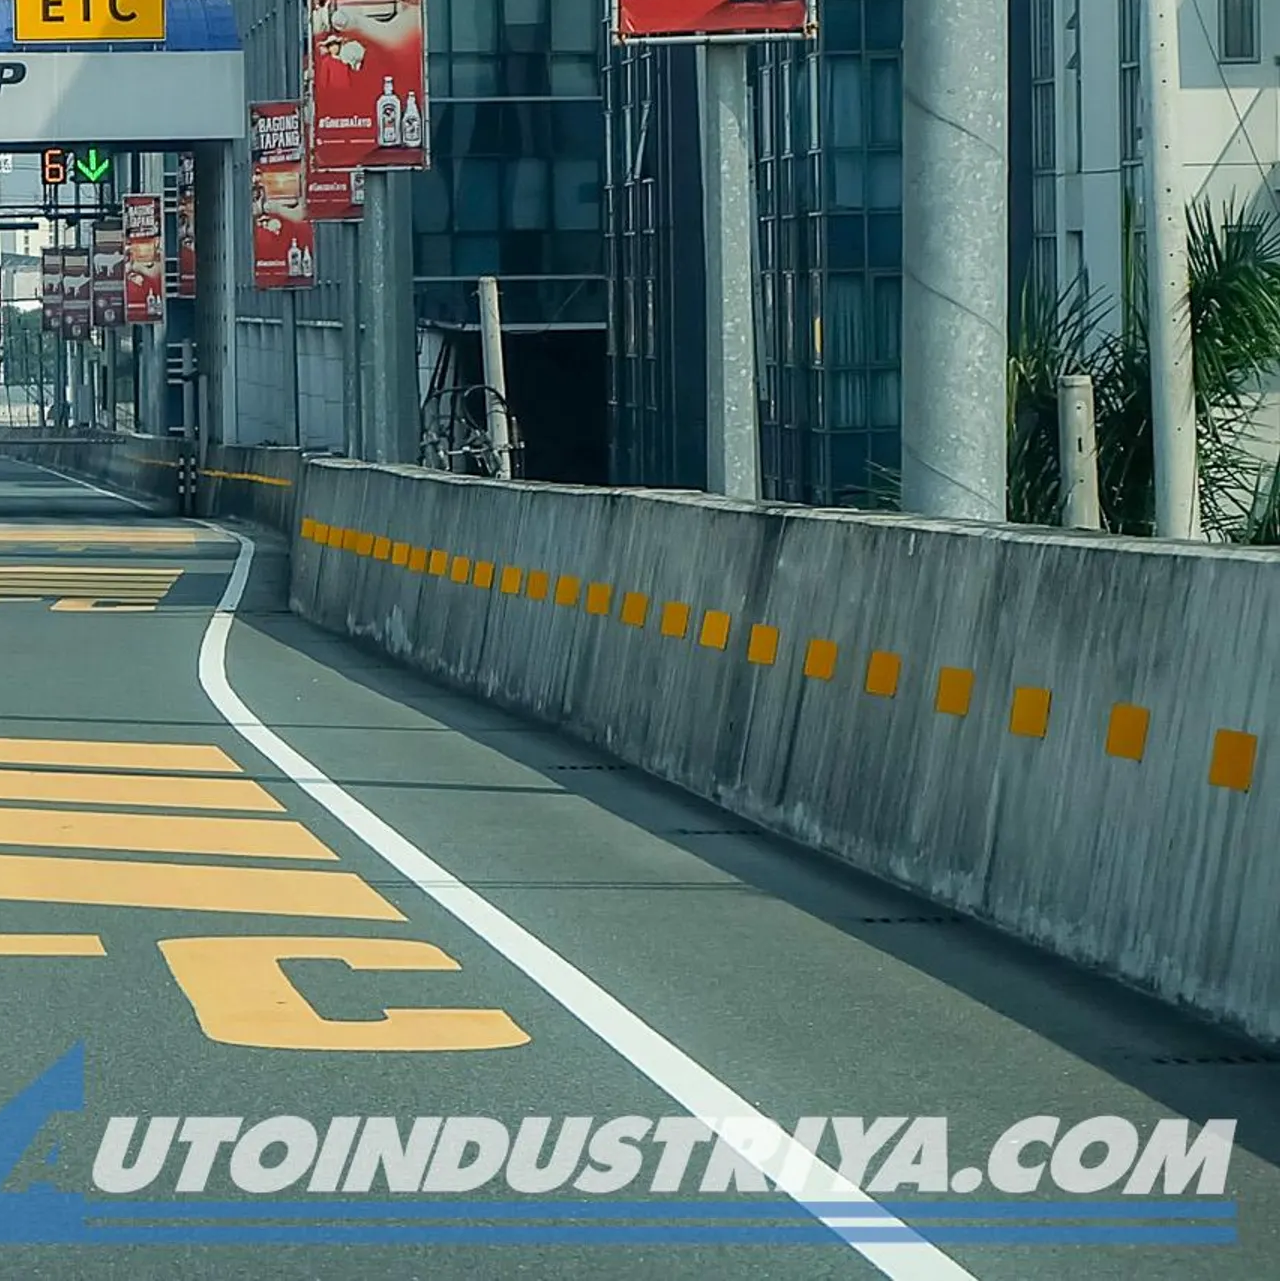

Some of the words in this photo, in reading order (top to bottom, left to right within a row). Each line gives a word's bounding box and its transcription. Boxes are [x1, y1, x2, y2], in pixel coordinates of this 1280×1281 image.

[259, 115, 299, 133] BAGONG
[260, 131, 301, 150] TAPANG
[44, 149, 64, 182] 6
